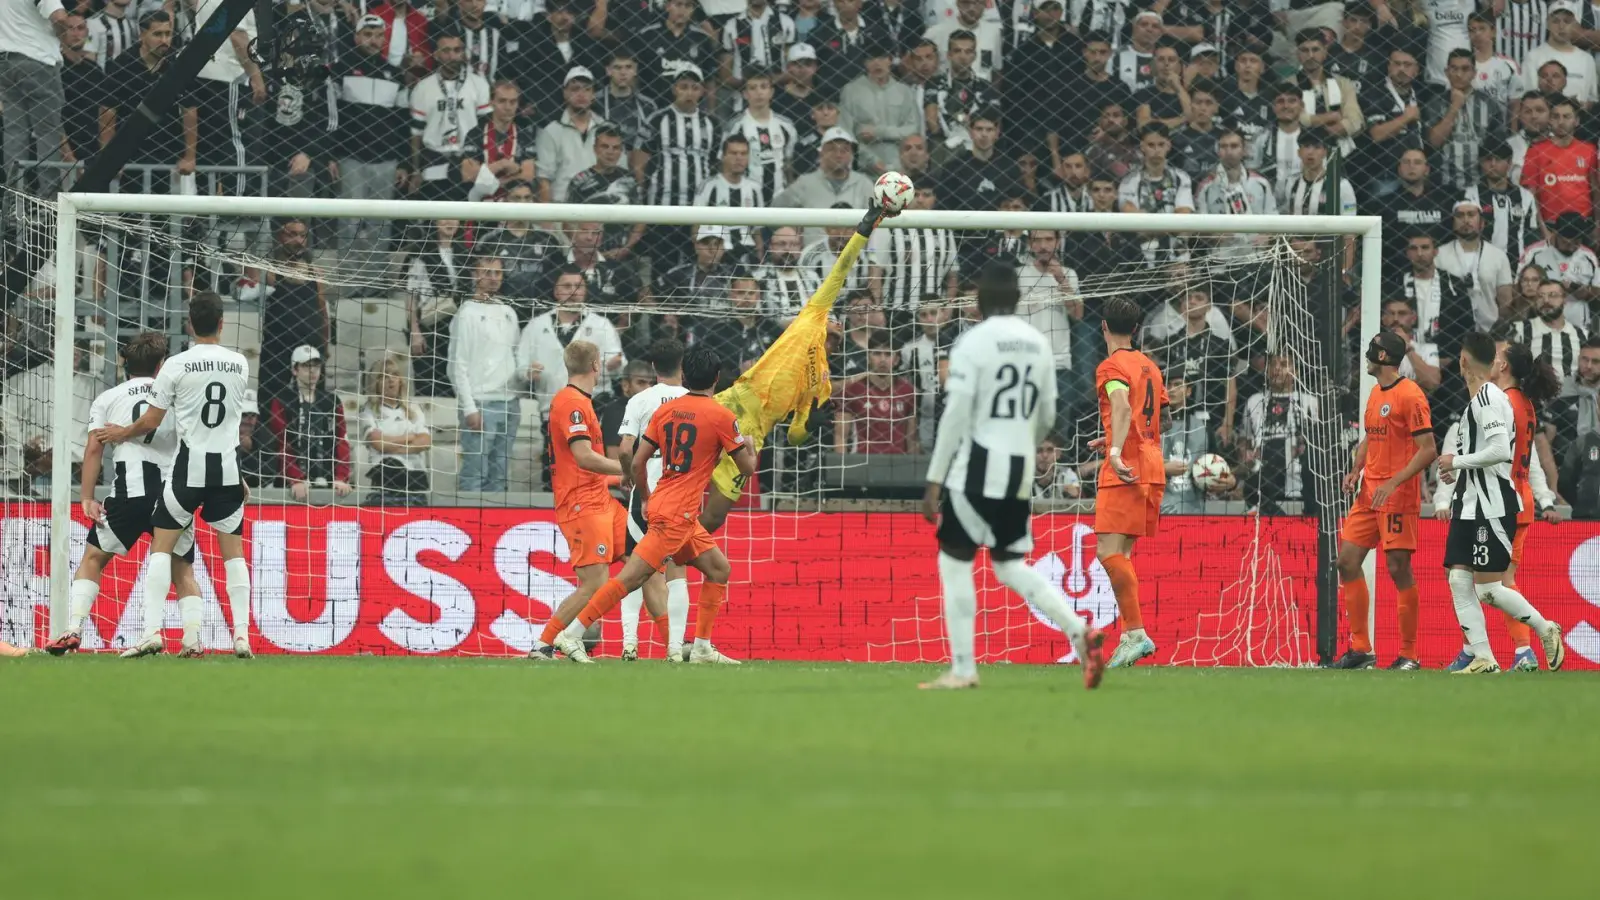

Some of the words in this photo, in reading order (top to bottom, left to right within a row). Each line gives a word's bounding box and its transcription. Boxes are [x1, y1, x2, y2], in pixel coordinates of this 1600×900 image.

[201, 381, 226, 429] 8
[989, 364, 1039, 420] 26
[1142, 378, 1155, 427] 4
[663, 422, 697, 473] 18
[1386, 513, 1404, 534] 15
